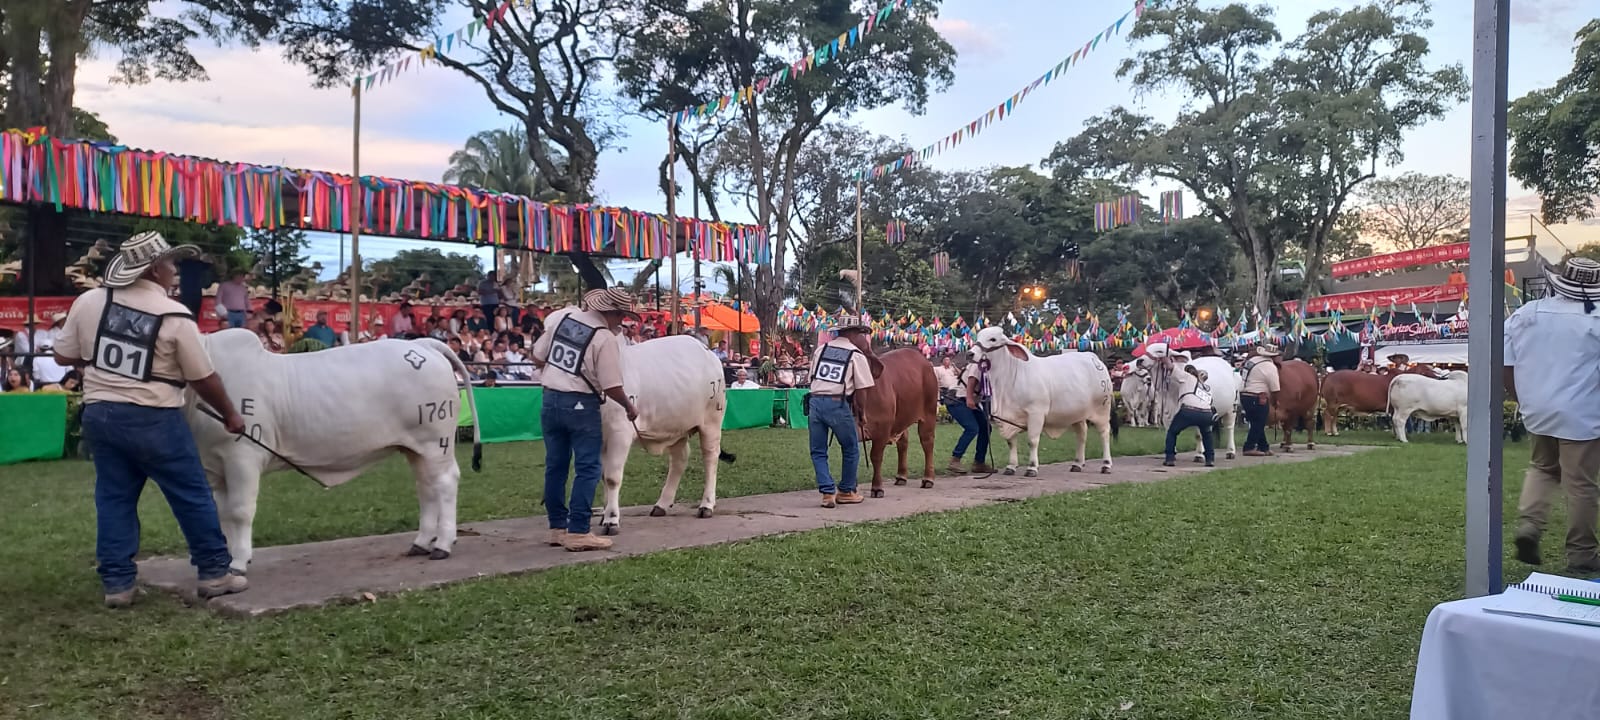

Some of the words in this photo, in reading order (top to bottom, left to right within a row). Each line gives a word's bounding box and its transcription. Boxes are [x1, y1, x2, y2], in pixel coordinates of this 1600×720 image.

[103, 343, 142, 375] 01
[552, 344, 577, 369] 03
[819, 364, 842, 380] 05
[241, 398, 254, 416] E
[418, 400, 453, 424] 1761
[440, 436, 449, 454] 4
